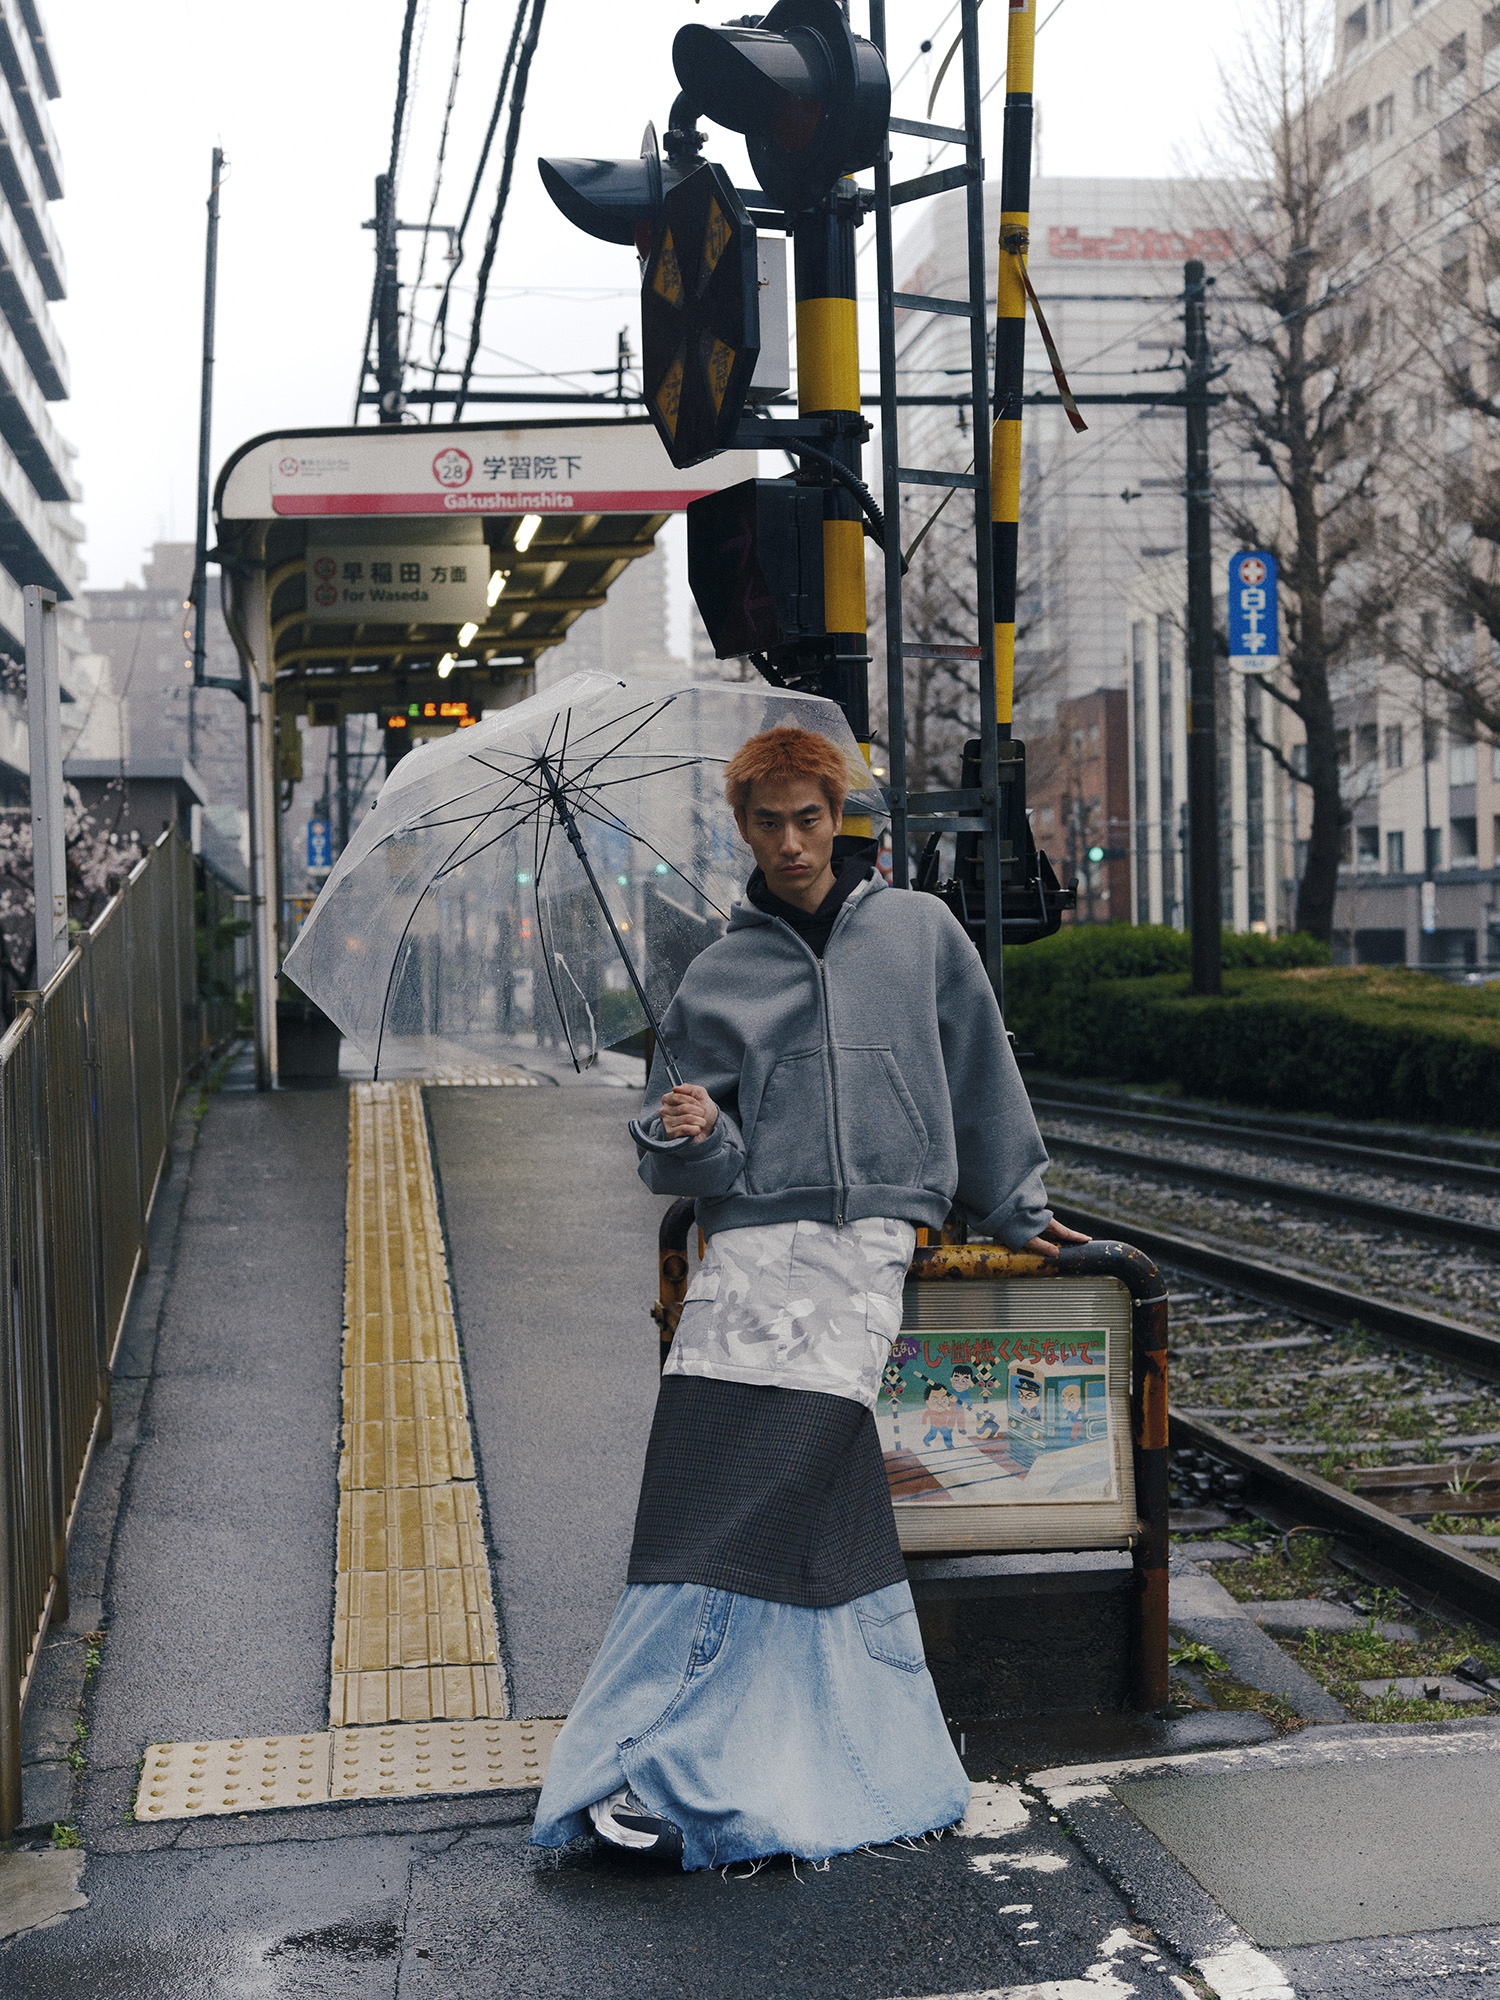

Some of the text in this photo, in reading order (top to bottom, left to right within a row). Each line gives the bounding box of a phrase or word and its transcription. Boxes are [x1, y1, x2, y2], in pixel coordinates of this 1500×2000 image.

[442, 465, 463, 479] 28
[483, 456, 582, 480] 学習院下
[444, 493, 574, 509] Gakushuinshita
[343, 562, 421, 584] 早稲田
[431, 566, 467, 583] 方面
[343, 588, 365, 601] for
[370, 588, 429, 602] Waseda
[924, 1338, 1099, 1368] しゃ断機くぐらないで
